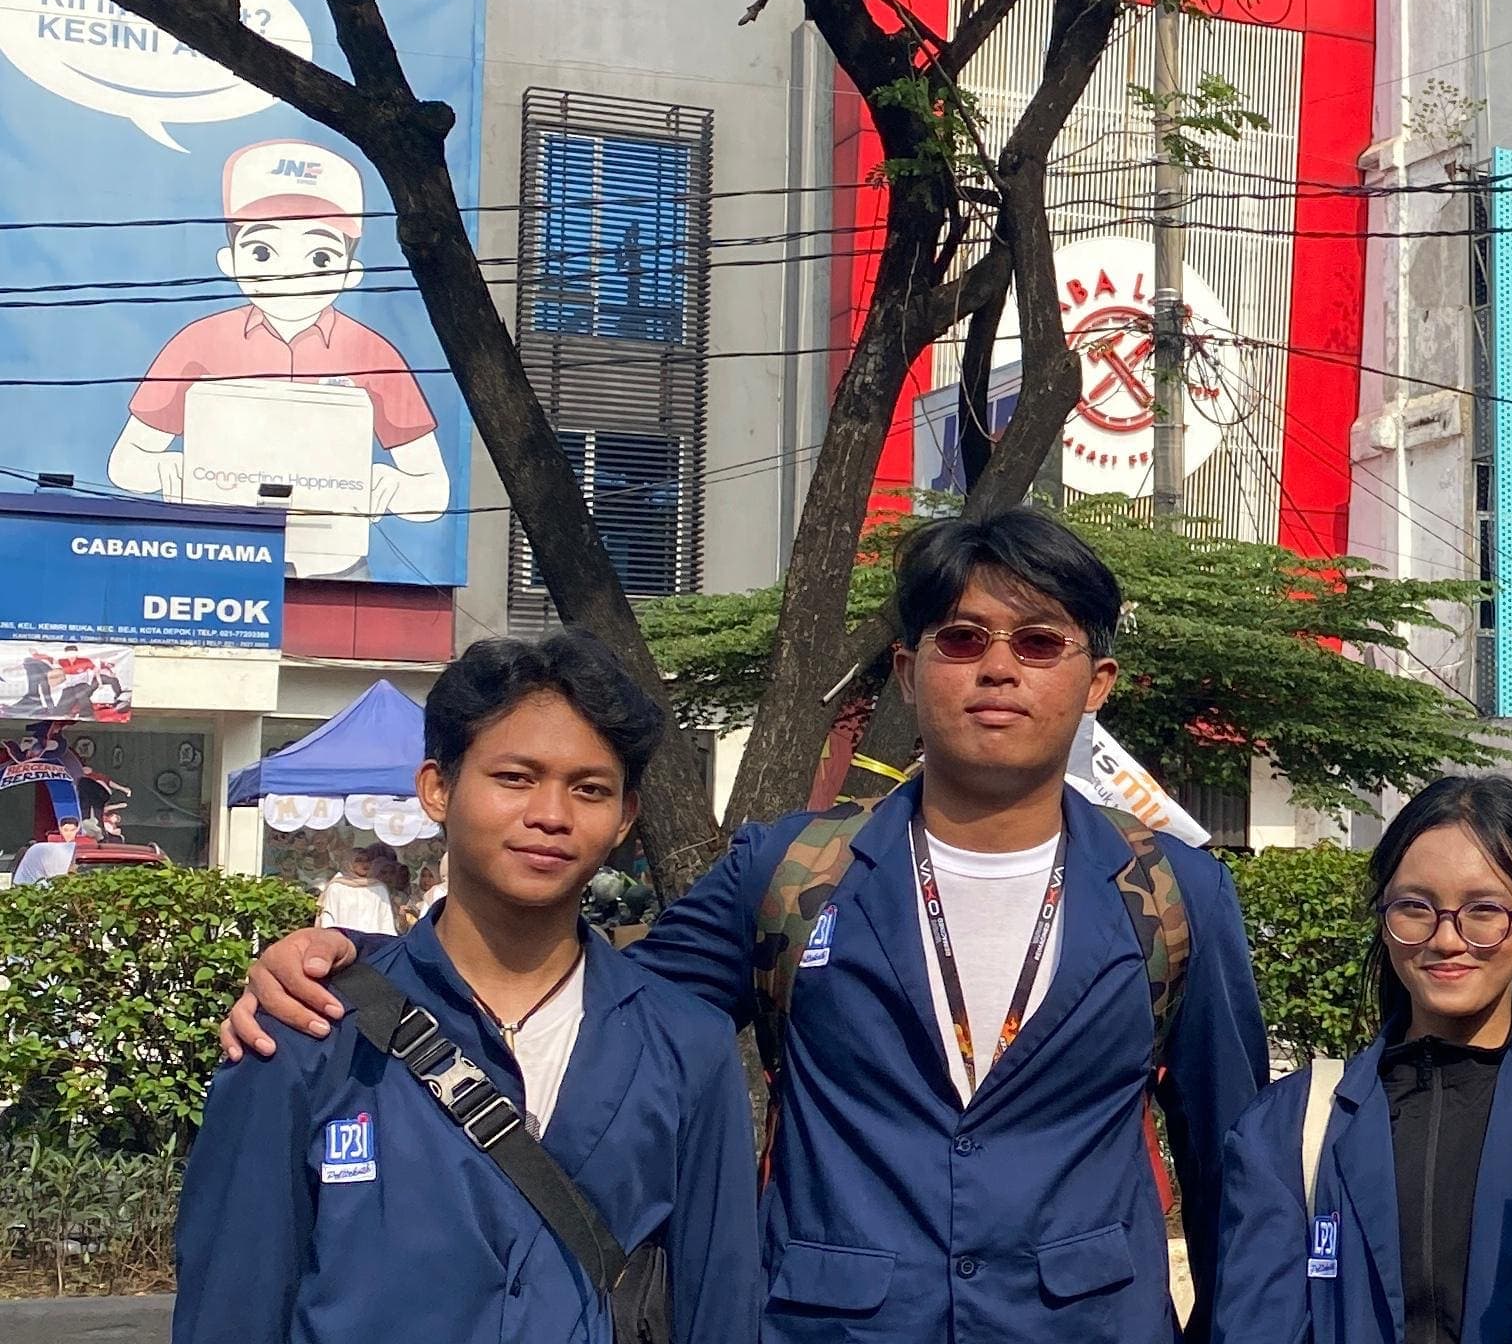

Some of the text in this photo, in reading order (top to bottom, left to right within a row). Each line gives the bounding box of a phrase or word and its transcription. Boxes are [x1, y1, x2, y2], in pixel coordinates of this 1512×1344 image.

[38, 14, 158, 53] KESINI
[270, 158, 322, 179] JNE
[289, 473, 364, 492] Happiness
[71, 537, 272, 564] CABANG UTAMA
[143, 594, 270, 624] DEPOK
[140, 627, 161, 635] KOTA
[163, 628, 191, 636] DEPOK
[329, 1121, 369, 1160] LP3I
